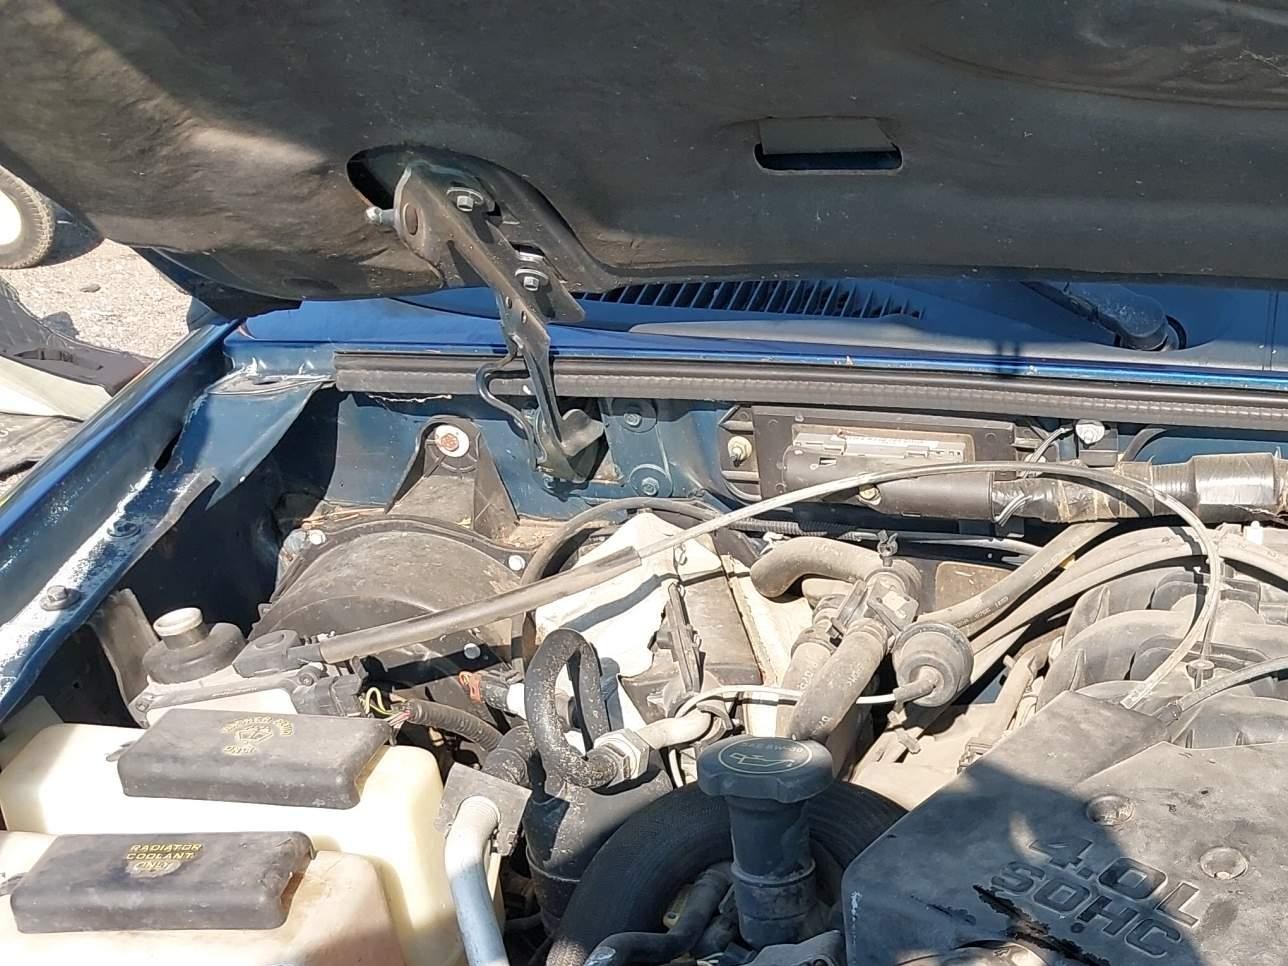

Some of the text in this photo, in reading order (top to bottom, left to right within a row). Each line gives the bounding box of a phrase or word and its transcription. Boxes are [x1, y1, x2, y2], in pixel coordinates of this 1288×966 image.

[130, 844, 203, 852] RADIATOR
[1028, 837, 1200, 928] 4.0L
[990, 861, 1181, 958] SOHC
